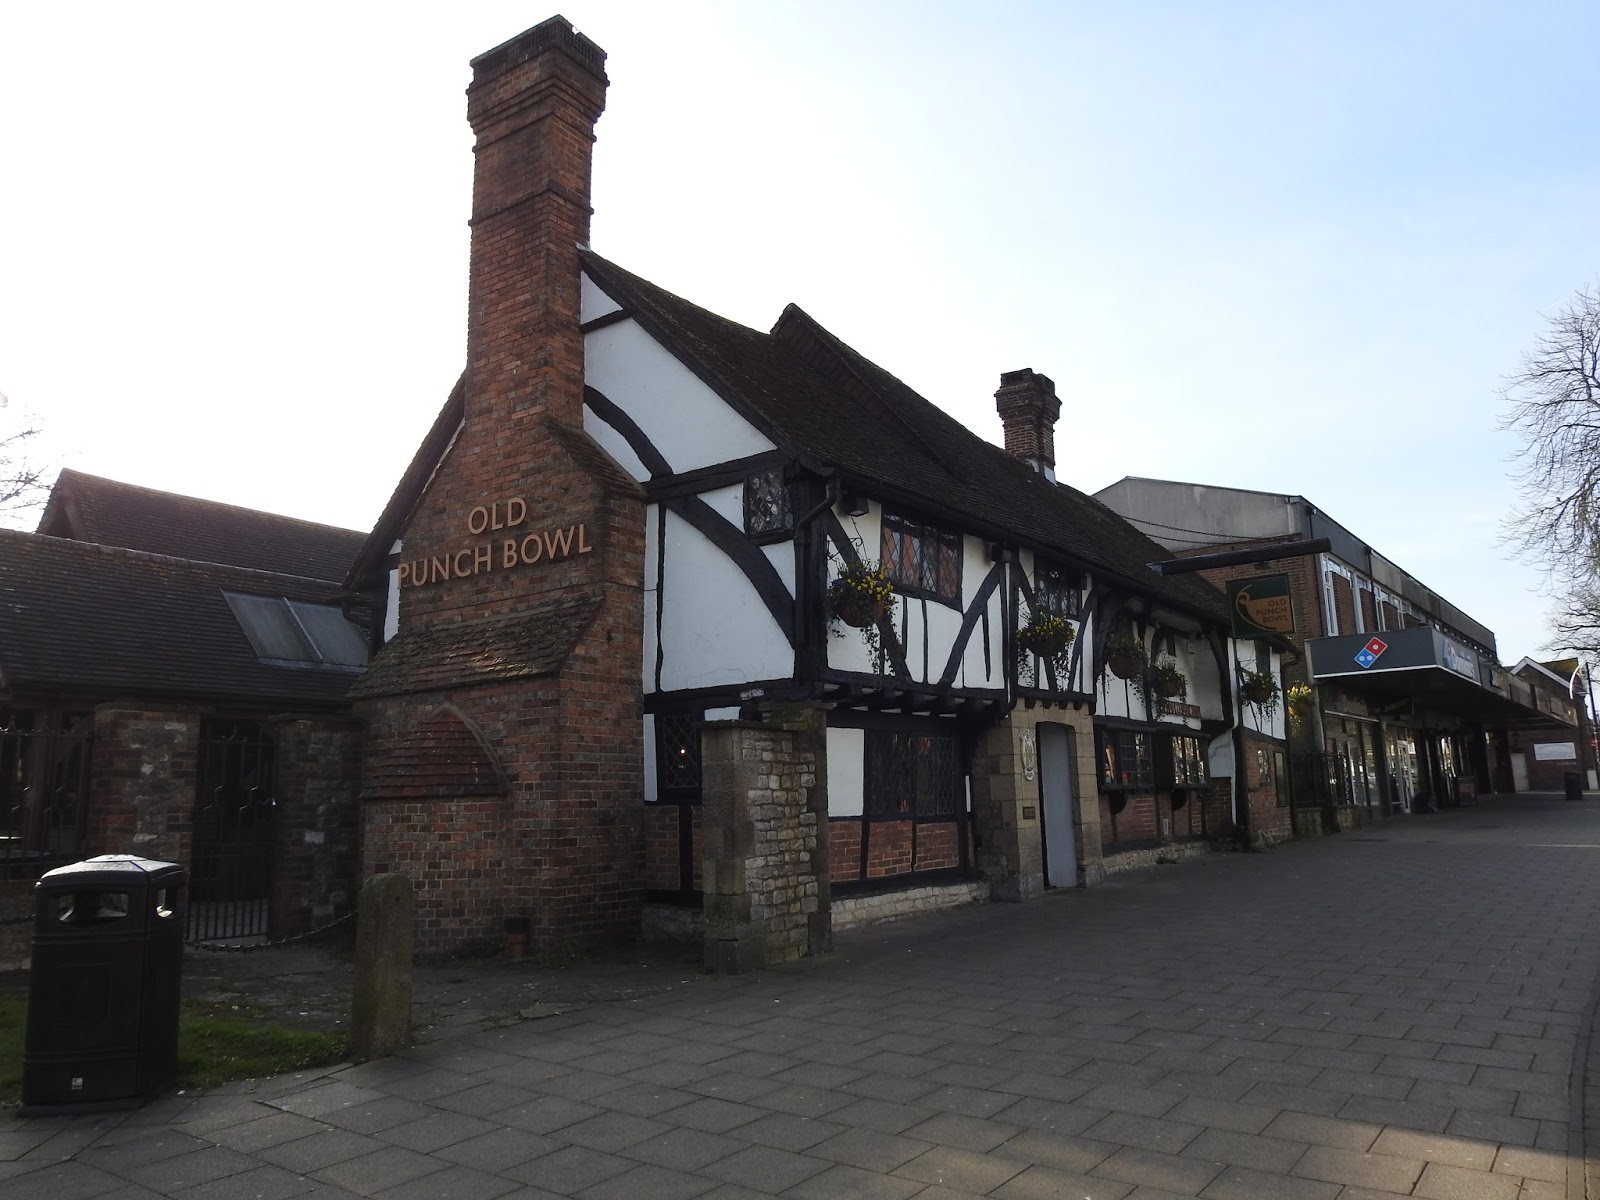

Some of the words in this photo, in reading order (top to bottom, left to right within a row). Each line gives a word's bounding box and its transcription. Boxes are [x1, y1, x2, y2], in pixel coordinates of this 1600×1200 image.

[468, 497, 527, 535] OLD
[398, 543, 492, 587] PUNCH
[503, 524, 592, 568] BOWL
[1268, 598, 1287, 607] OLD
[1255, 606, 1288, 616] PUNCH
[1262, 614, 1290, 623] BOWL
